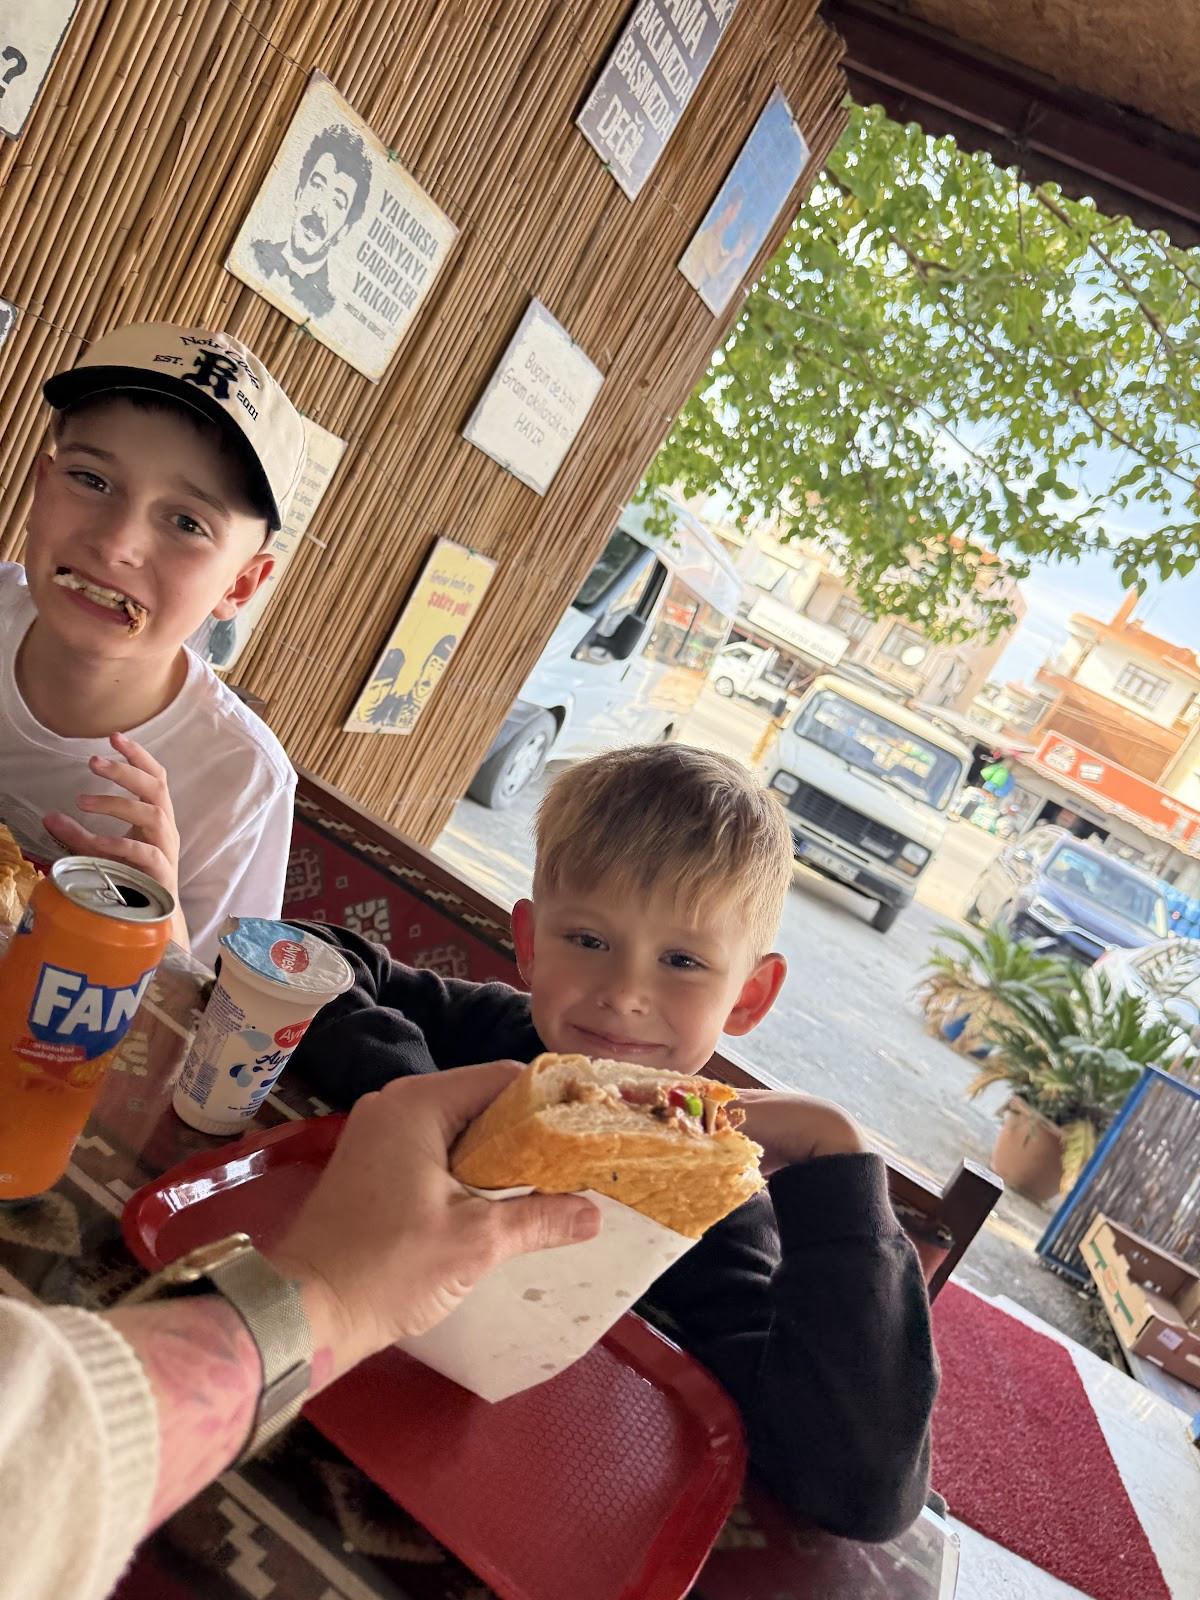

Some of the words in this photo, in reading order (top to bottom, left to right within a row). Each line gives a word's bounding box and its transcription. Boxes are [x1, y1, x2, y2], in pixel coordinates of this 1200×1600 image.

[380, 189, 439, 261] YAKARSA
[367, 217, 428, 287] DÜNYAYI
[352, 271, 403, 326] YAKAR!
[179, 336, 223, 349] Noir
[153, 354, 184, 366] EST.
[501, 367, 528, 401] Gram
[236, 390, 259, 421] 2001
[513, 412, 545, 448] HAYIR
[281, 943, 302, 971] Aynes
[31, 967, 157, 1036] FAN
[278, 1028, 307, 1043] Ayn
